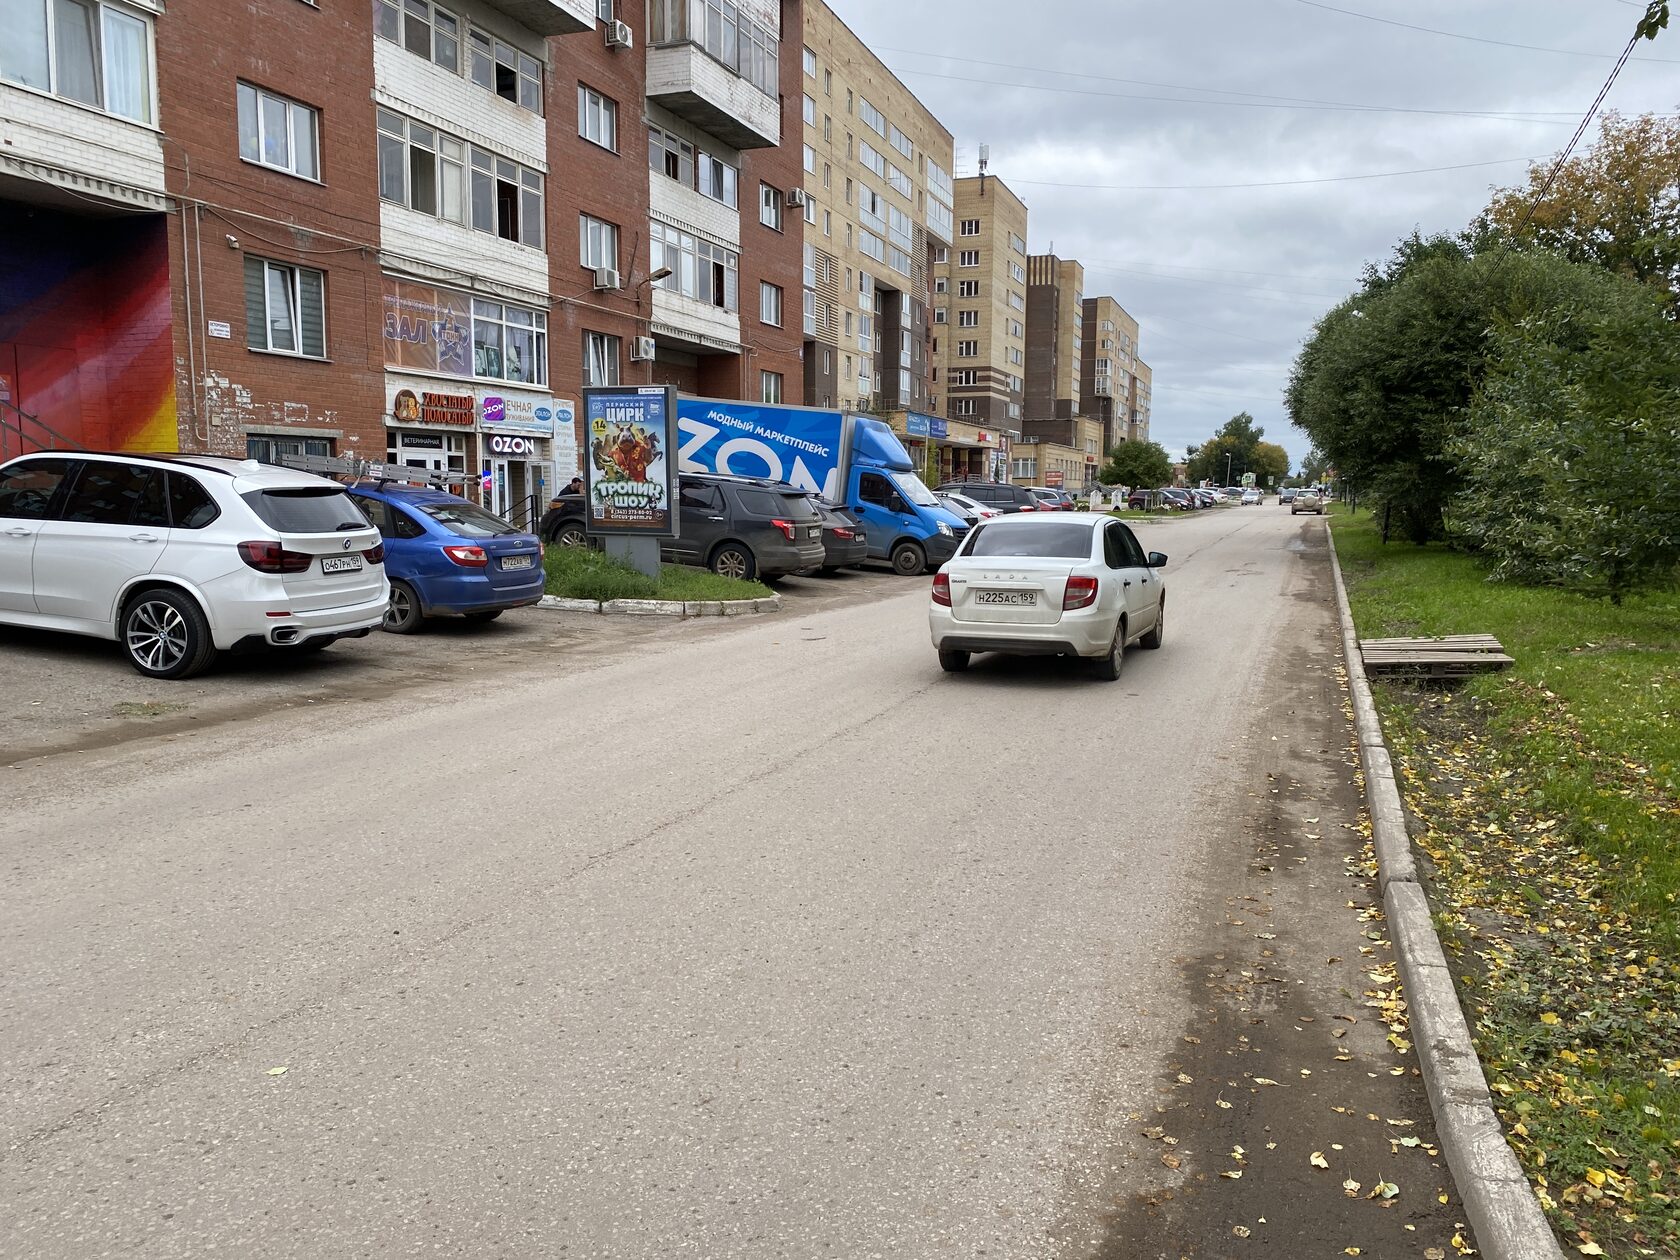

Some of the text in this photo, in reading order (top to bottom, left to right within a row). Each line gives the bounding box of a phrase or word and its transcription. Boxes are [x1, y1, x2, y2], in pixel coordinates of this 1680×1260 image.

[384, 312, 428, 345] ЗАЛ
[423, 392, 474, 410] ХВОСТАТЫЙ
[482, 403, 504, 417] OZON
[506, 400, 532, 413] ЕЧНАЯ
[424, 407, 474, 425] ПОЛОСАТЫЙ
[606, 407, 645, 423] ЦИРК
[594, 420, 606, 429] 14
[707, 410, 830, 458] МОДНЫЙ МАРКЕТПЛЕЙС
[492, 436, 535, 454] OZON
[678, 416, 838, 500] ZON
[596, 481, 662, 499] ТРОПИК
[614, 495, 648, 508] ШОУ
[978, 592, 1034, 603] Н225АС 159
